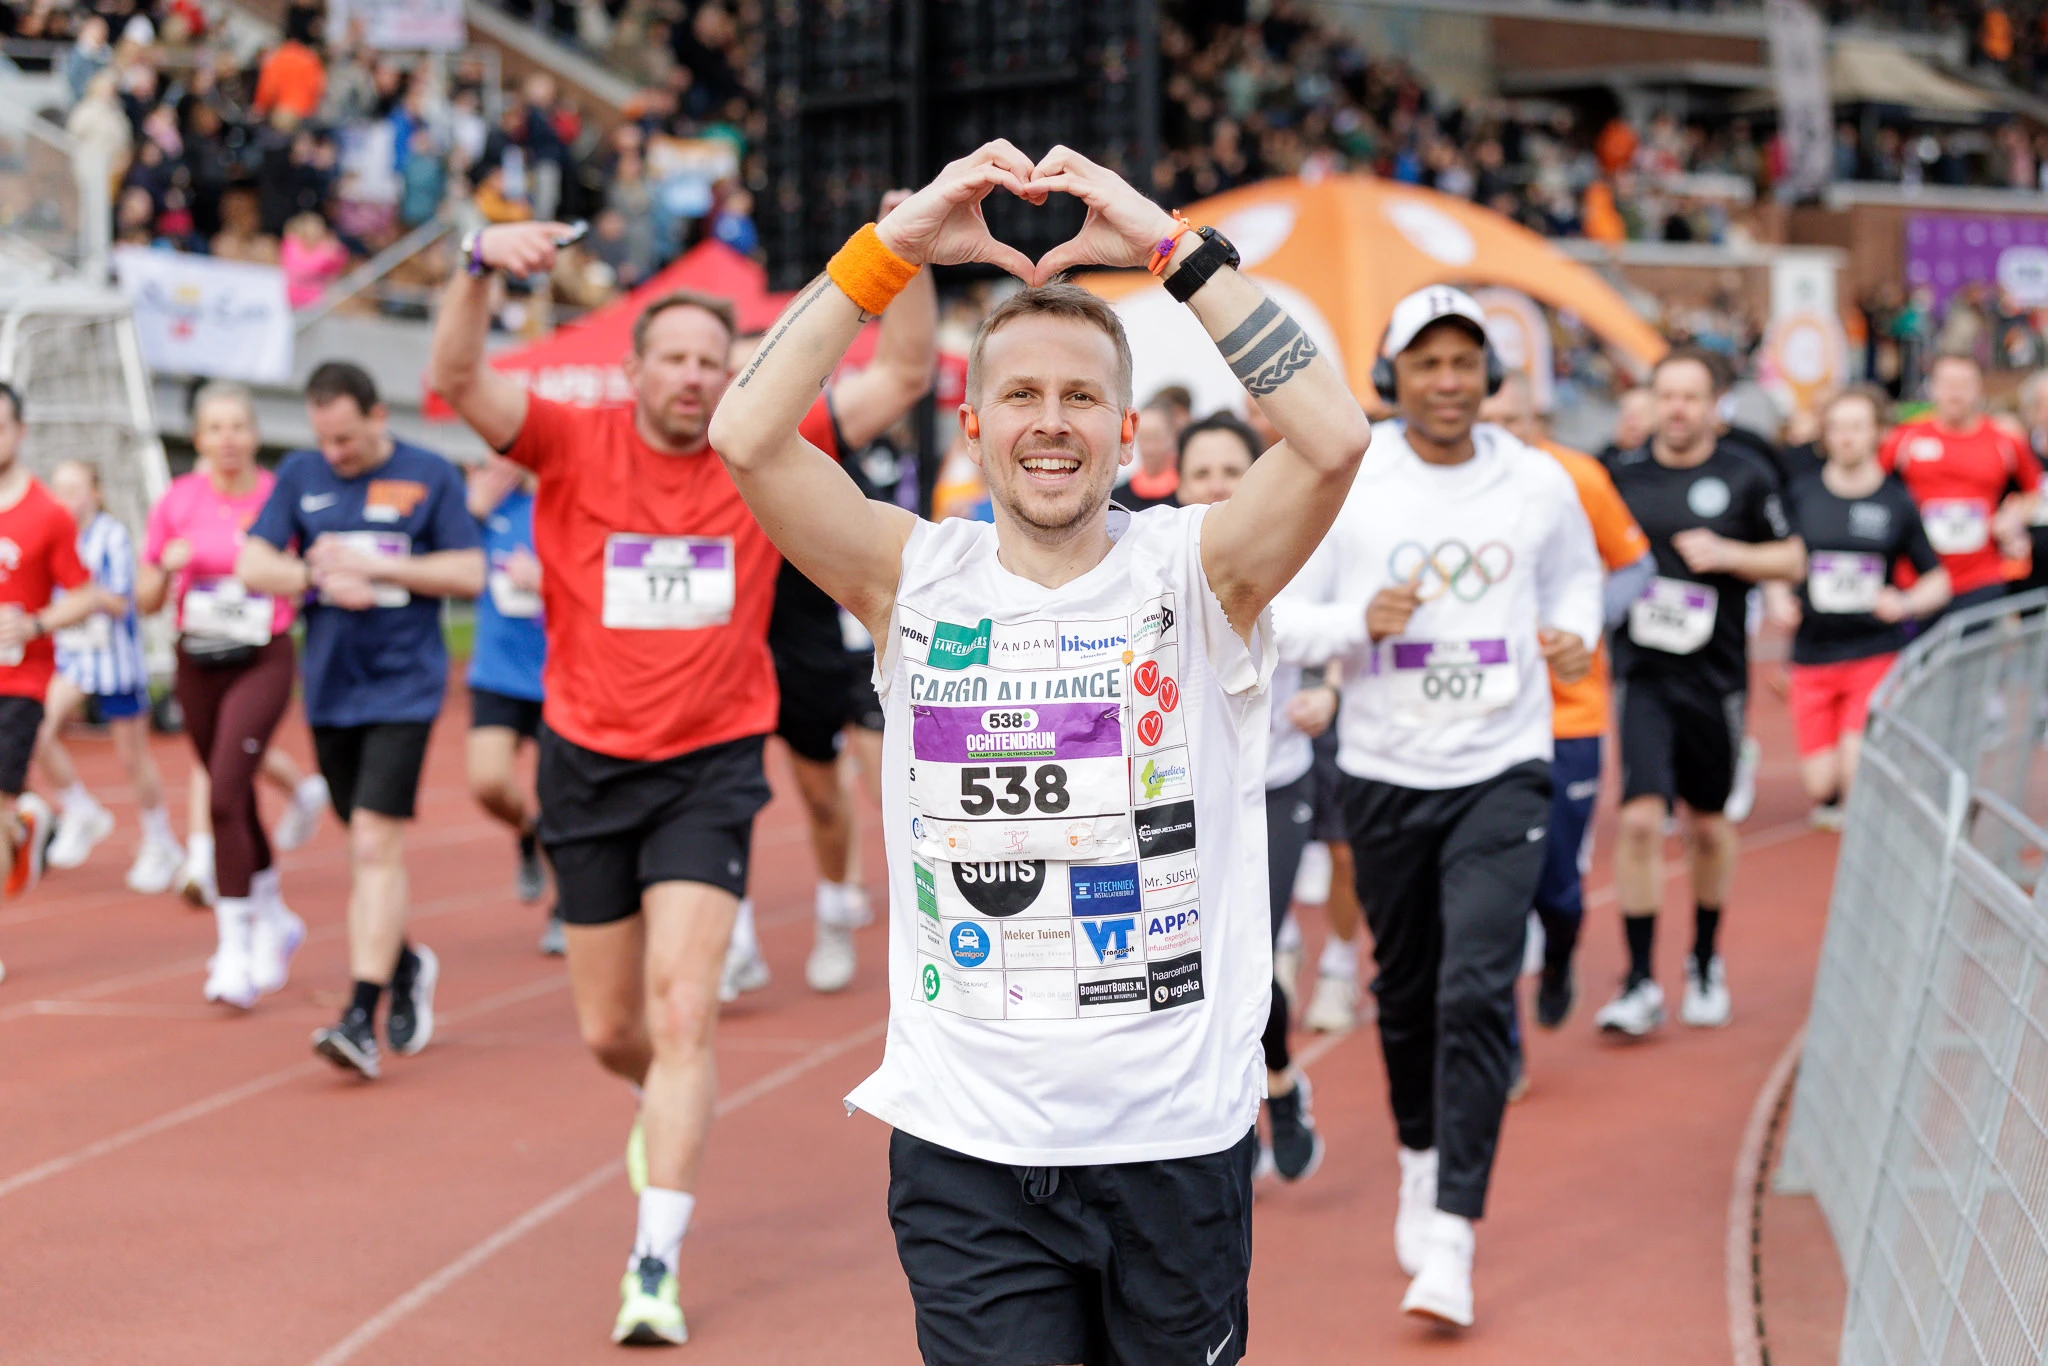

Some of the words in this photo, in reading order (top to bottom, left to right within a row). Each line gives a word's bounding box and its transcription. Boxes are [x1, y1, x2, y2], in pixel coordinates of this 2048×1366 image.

[647, 573, 690, 603] 171
[1060, 634, 1127, 652] bisous
[911, 673, 987, 702] CARGO
[1422, 672, 1485, 700] 007
[989, 712, 1023, 729] 538
[966, 731, 1056, 751] OCHTENDRUN
[960, 763, 1071, 816] 538
[1094, 879, 1135, 893] I-TECHNIEK
[1144, 877, 1163, 889] Mr.
[1166, 867, 1197, 885] SUSHI
[1005, 929, 1035, 940] Meker
[1038, 928, 1071, 940] Tuinen
[1080, 917, 1135, 964] VT
[1102, 945, 1135, 957] Transport
[1152, 962, 1199, 981] haarcentrum
[1080, 981, 1146, 996] BOOMHUTBORIS.NL
[1170, 979, 1200, 998] ugeka
